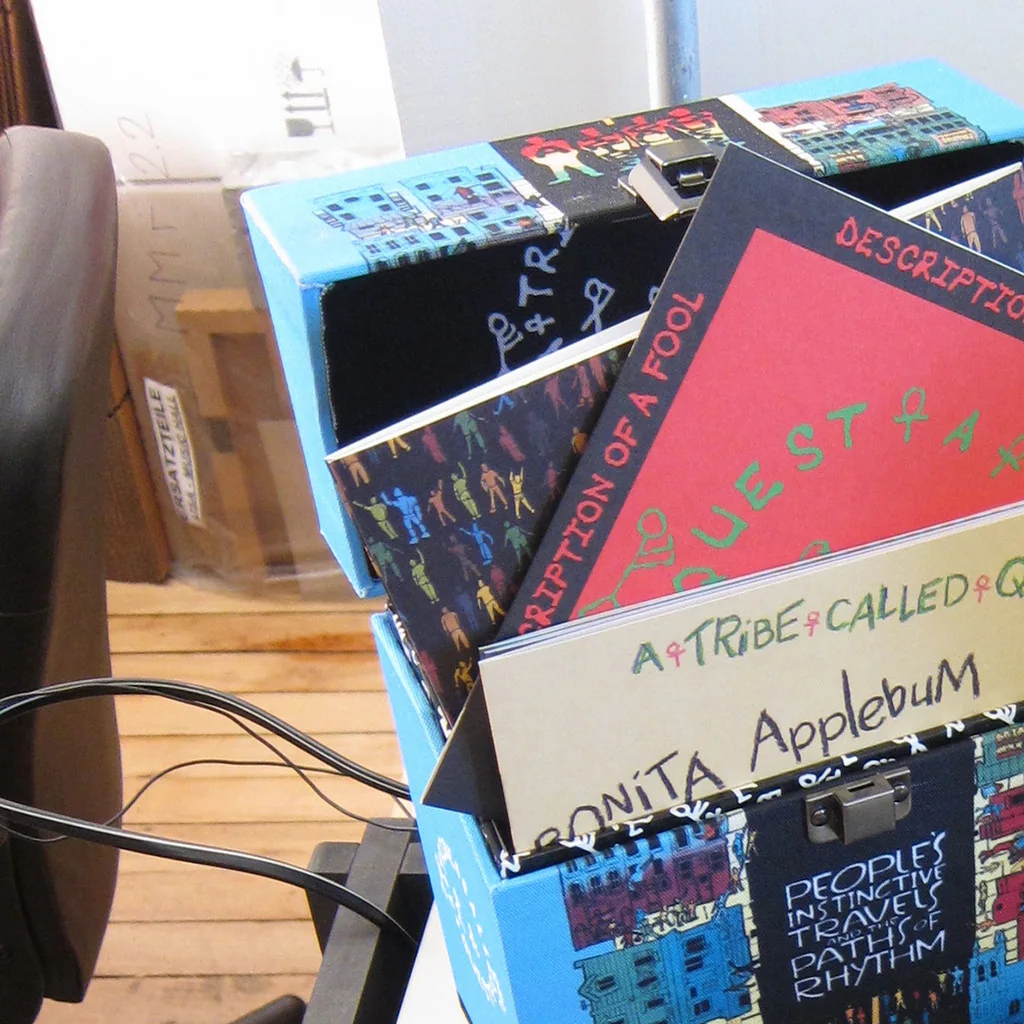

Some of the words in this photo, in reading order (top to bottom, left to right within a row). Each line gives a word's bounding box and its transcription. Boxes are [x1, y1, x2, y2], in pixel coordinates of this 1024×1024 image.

[641, 292, 705, 381] FOOL
[628, 391, 659, 418] A
[943, 409, 980, 453] A
[604, 416, 638, 467] OF
[631, 640, 664, 675] A
[825, 572, 970, 633] CALLED
[785, 831, 946, 910] PEOPLE'S
[787, 863, 947, 927] INSTINCTIVE
[788, 880, 943, 947] TRAVELS
[790, 916, 912, 979] PATHS
[913, 911, 942, 931] OF
[827, 928, 862, 946] AND
[794, 930, 946, 1002] RHYTHM
